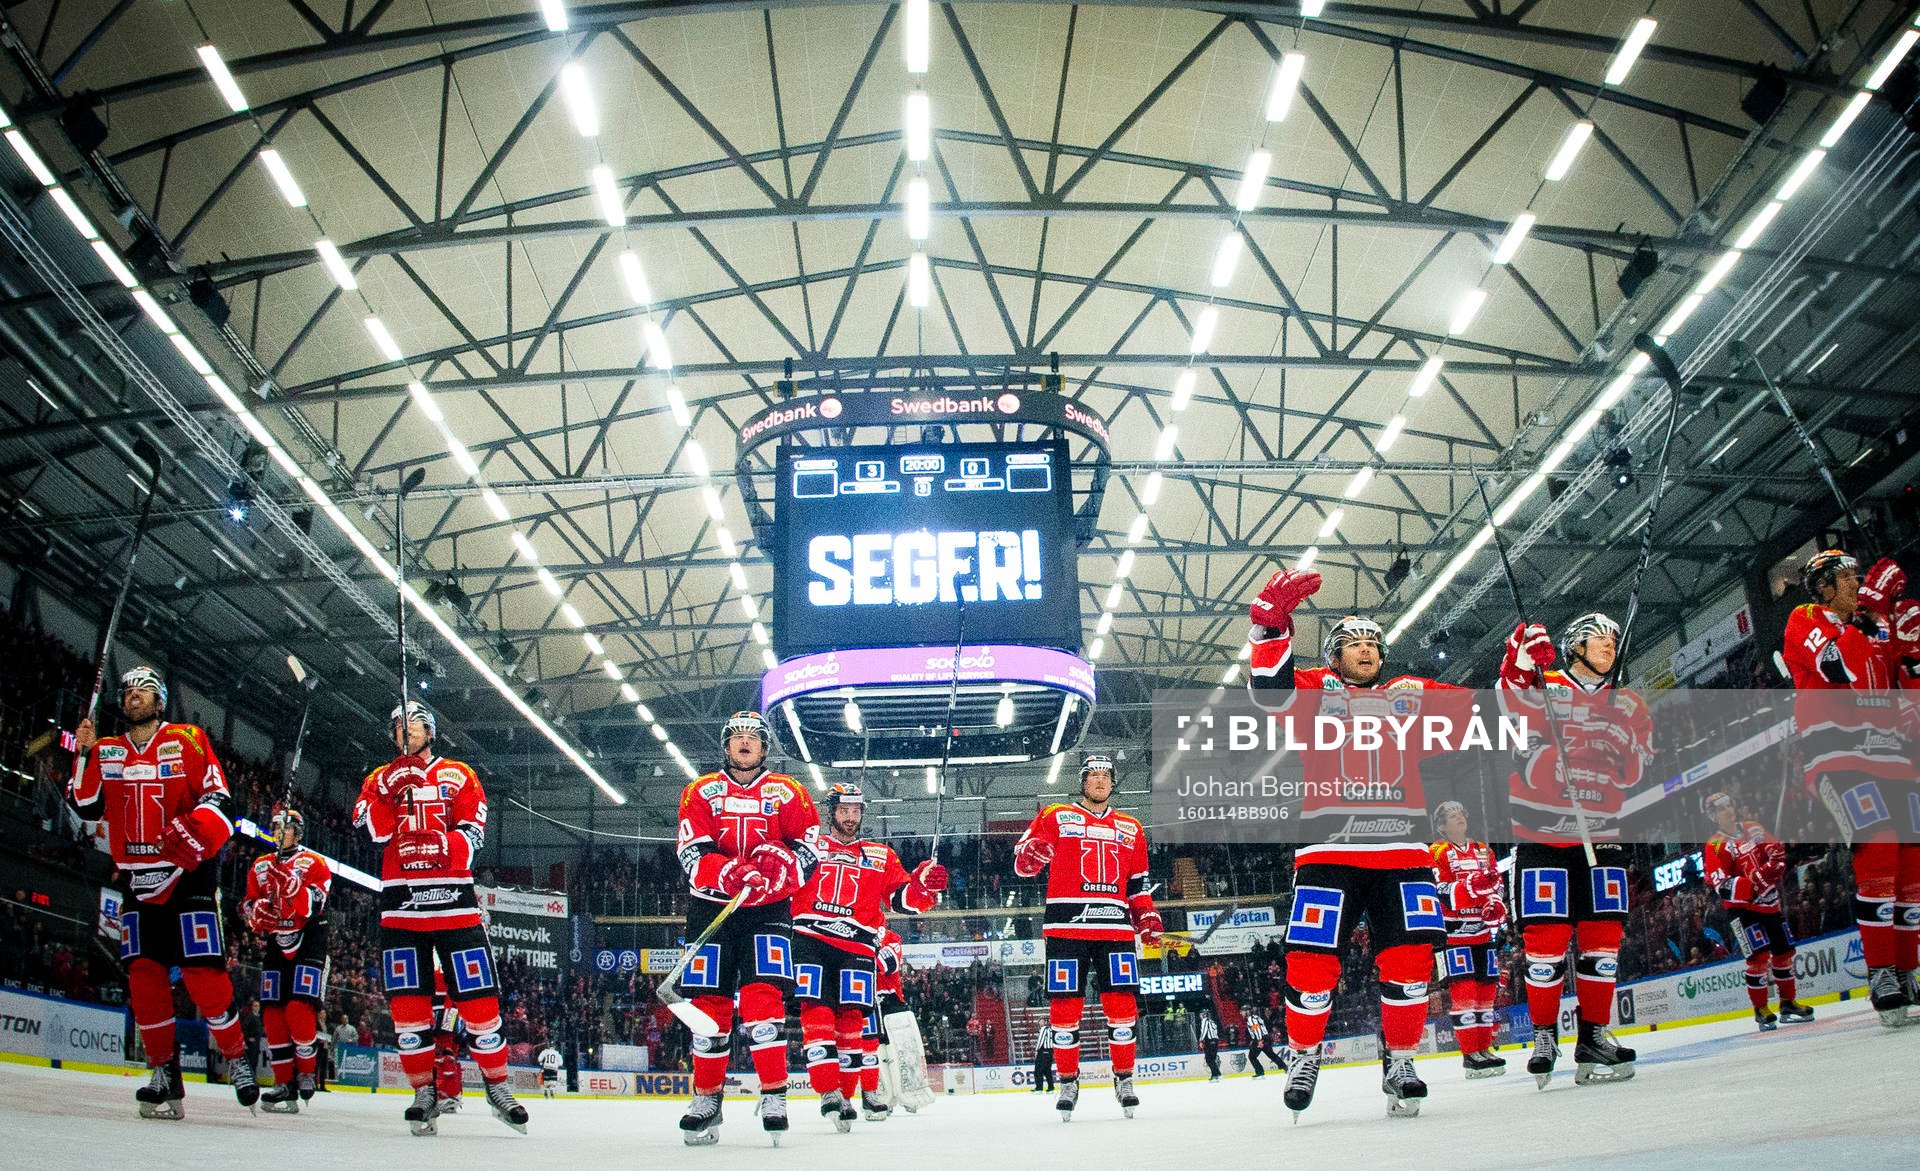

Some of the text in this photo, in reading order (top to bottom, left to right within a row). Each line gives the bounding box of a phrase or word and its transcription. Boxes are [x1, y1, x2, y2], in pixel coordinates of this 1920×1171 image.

[891, 397, 994, 415] Swedbank
[740, 403, 817, 444] Swedbank
[808, 529, 1043, 607] SEGER!
[1804, 627, 1827, 653] 12
[203, 764, 225, 789] 25
[1562, 785, 1602, 801] EBRO
[1083, 882, 1118, 894] ÖREBRO
[815, 902, 853, 916] ÖREBRO
[1193, 910, 1270, 927] Vintrgatan
[487, 921, 551, 944] stavsvik
[1140, 974, 1203, 995] SEGER!
[0, 1014, 41, 1036] TON
[546, 1054, 556, 1064] 10
[1137, 1060, 1189, 1073] HOIST
[590, 1078, 617, 1091] EEL
